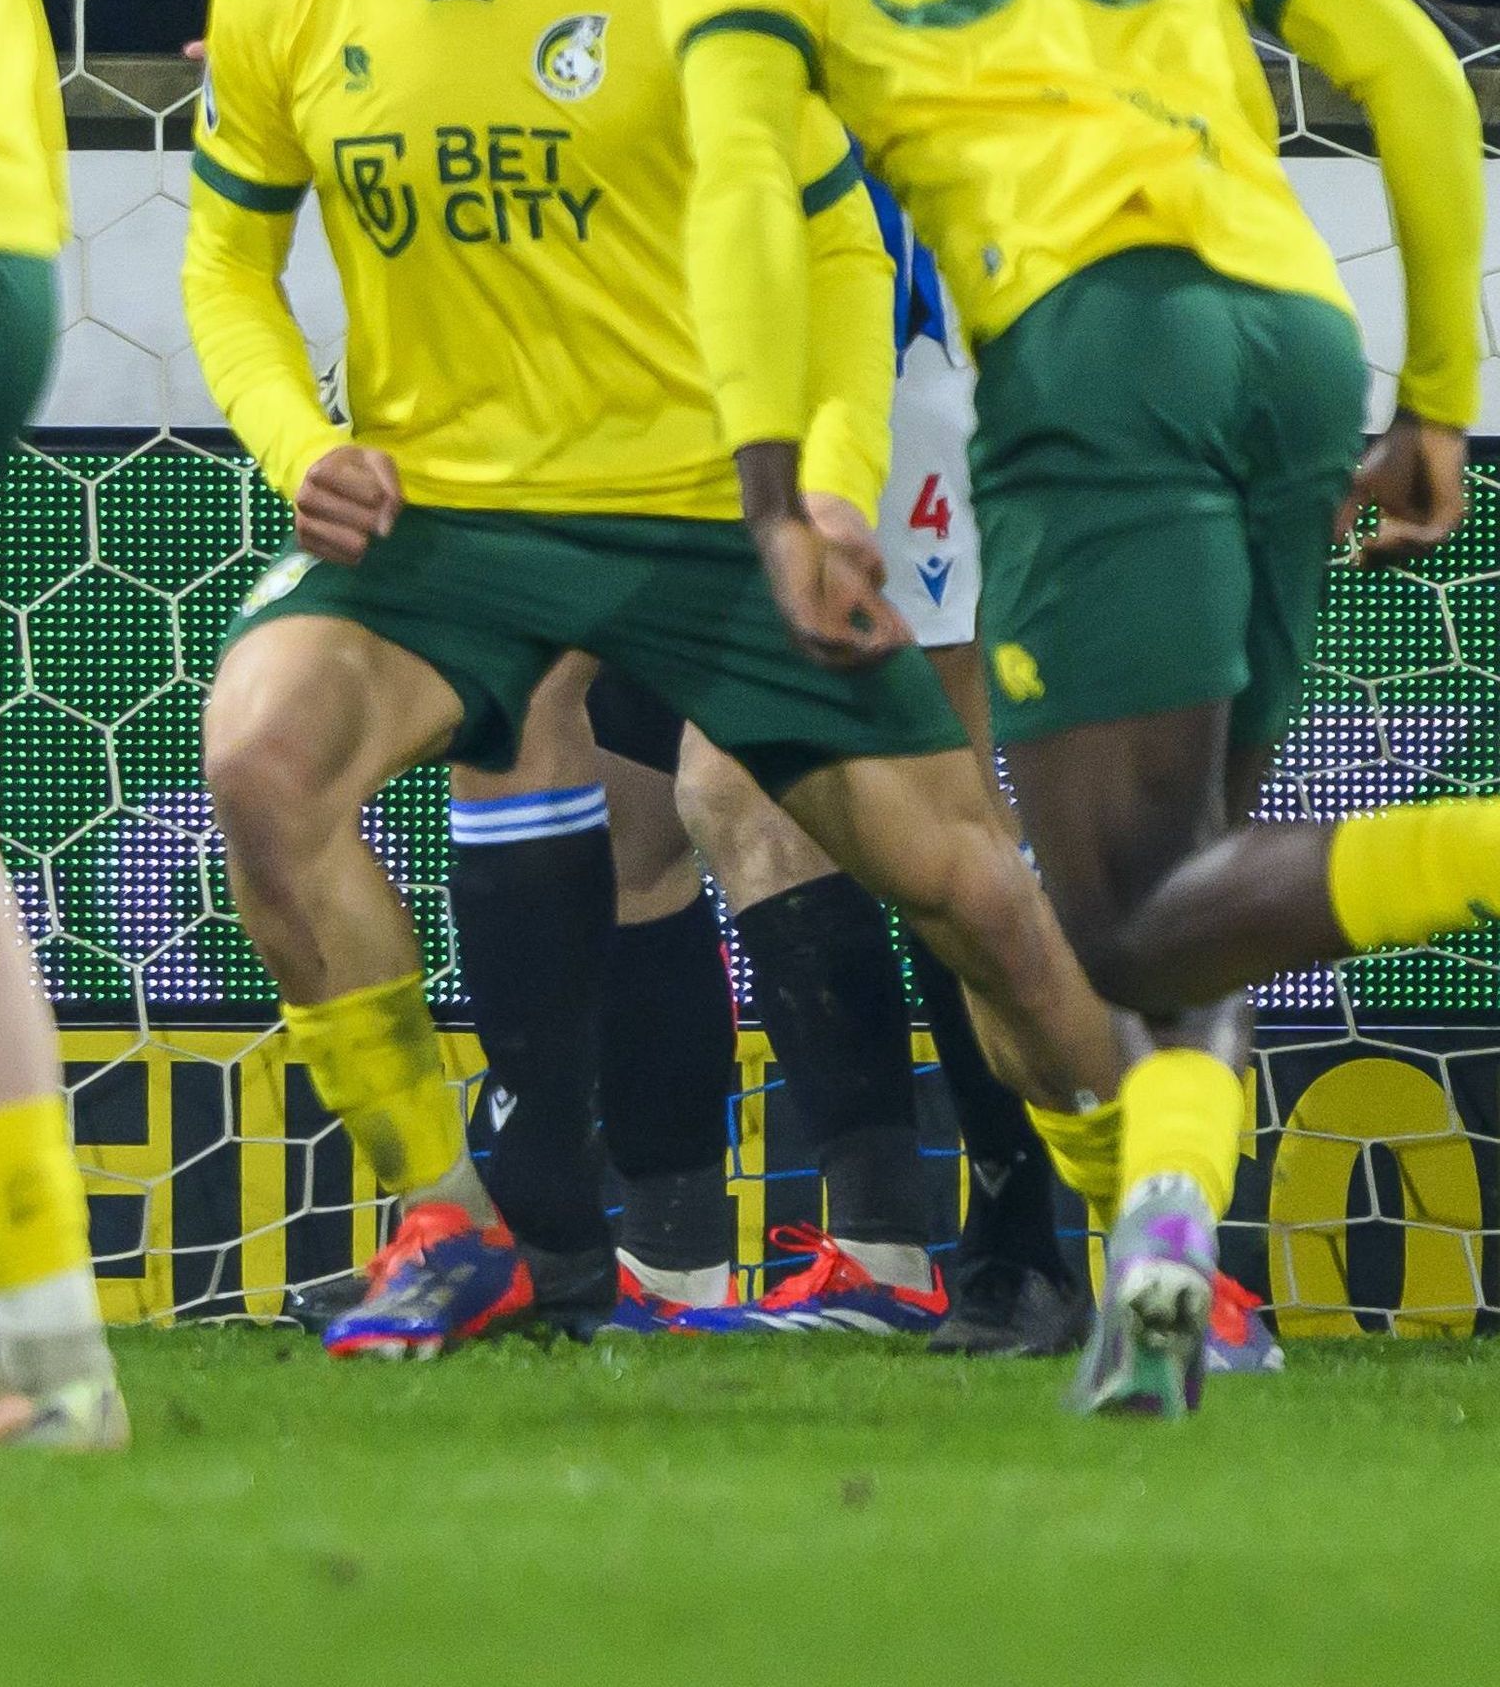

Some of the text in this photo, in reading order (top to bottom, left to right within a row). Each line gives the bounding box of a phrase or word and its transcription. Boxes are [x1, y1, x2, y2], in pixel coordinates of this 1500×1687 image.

[435, 125, 571, 185] BET
[444, 187, 603, 244] CITY
[909, 472, 952, 540] 4
